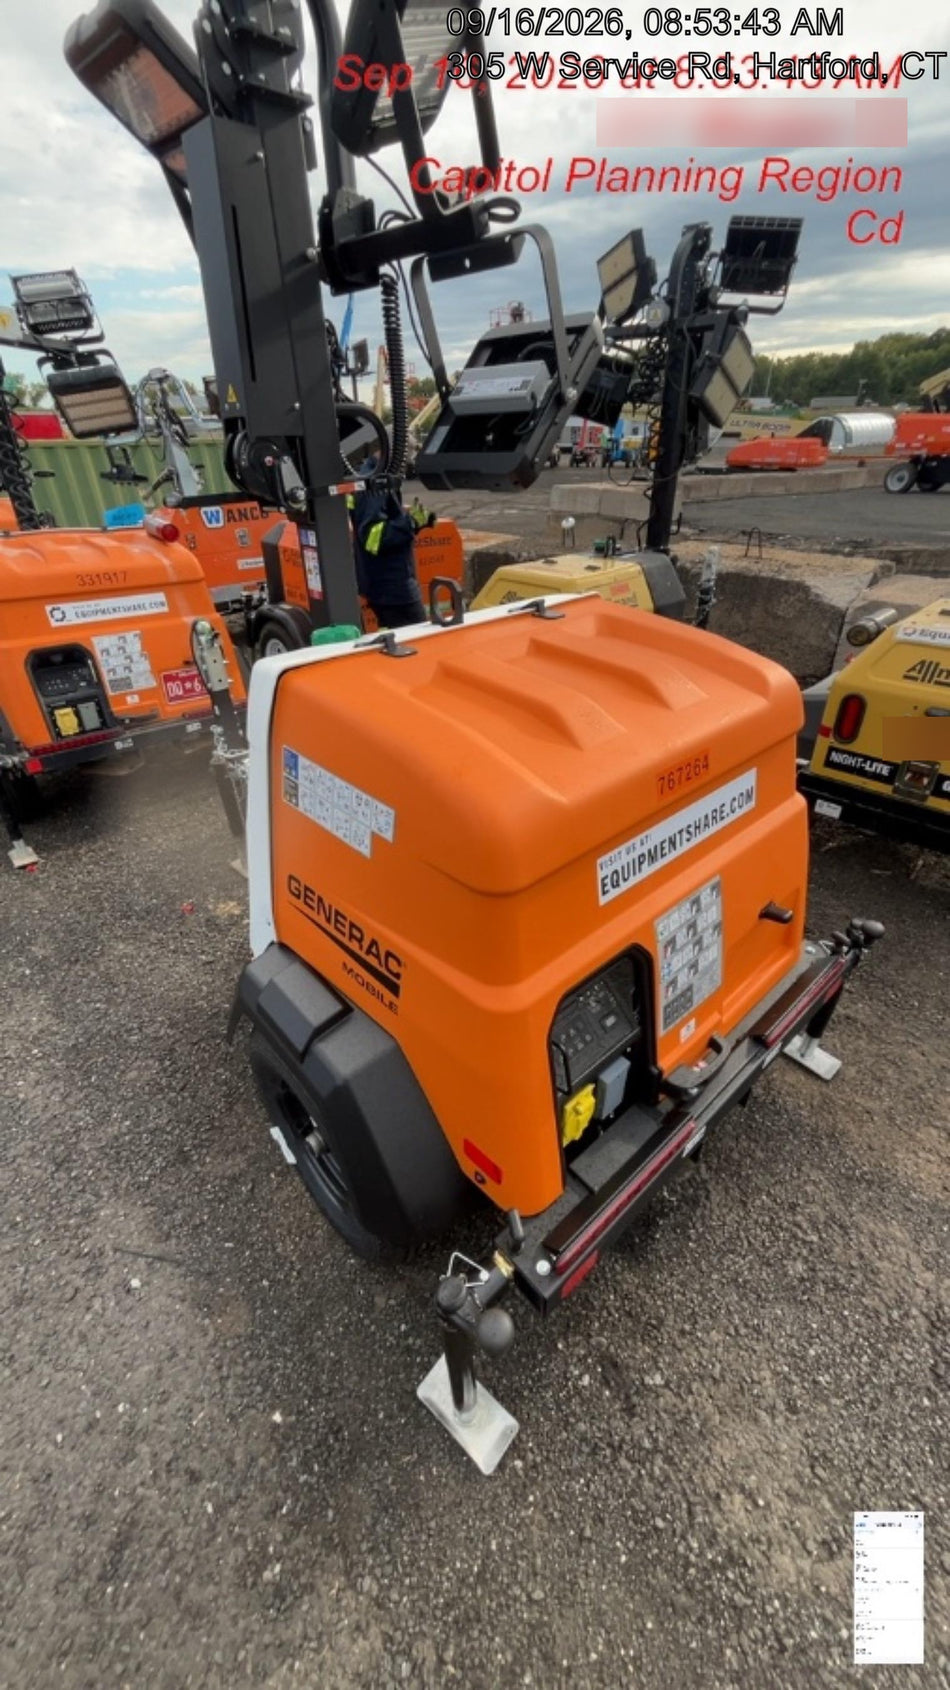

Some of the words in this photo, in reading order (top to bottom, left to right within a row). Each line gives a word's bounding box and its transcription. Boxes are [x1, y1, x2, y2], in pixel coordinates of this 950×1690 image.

[76, 571, 127, 588] 331917
[657, 754, 710, 796] 767264
[829, 750, 891, 777] NIGHT-LITE
[600, 785, 754, 897] EQUIPMENTSHARE.COM
[287, 873, 403, 981] GENERAC
[341, 961, 399, 1016] MOBILE
